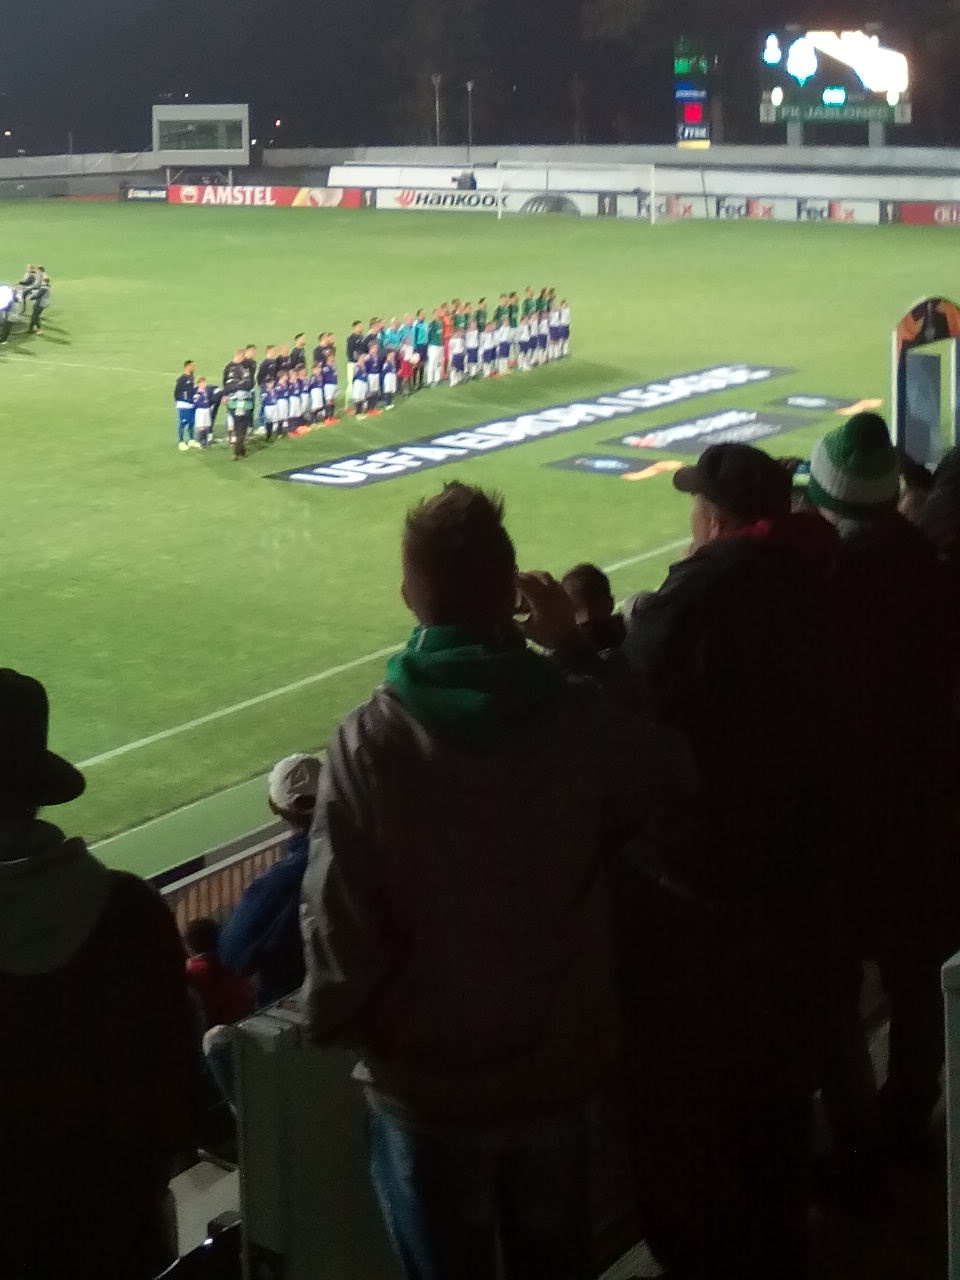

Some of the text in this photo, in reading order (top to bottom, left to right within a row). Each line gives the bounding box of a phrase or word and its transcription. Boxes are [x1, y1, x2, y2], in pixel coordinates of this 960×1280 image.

[201, 186, 276, 205] AMSTEL
[716, 196, 773, 219] FedEx
[797, 200, 855, 222] FedEx
[290, 446, 469, 484] UEFA
[431, 403, 634, 450] EUROPA
[597, 365, 771, 408] LEAGUE
